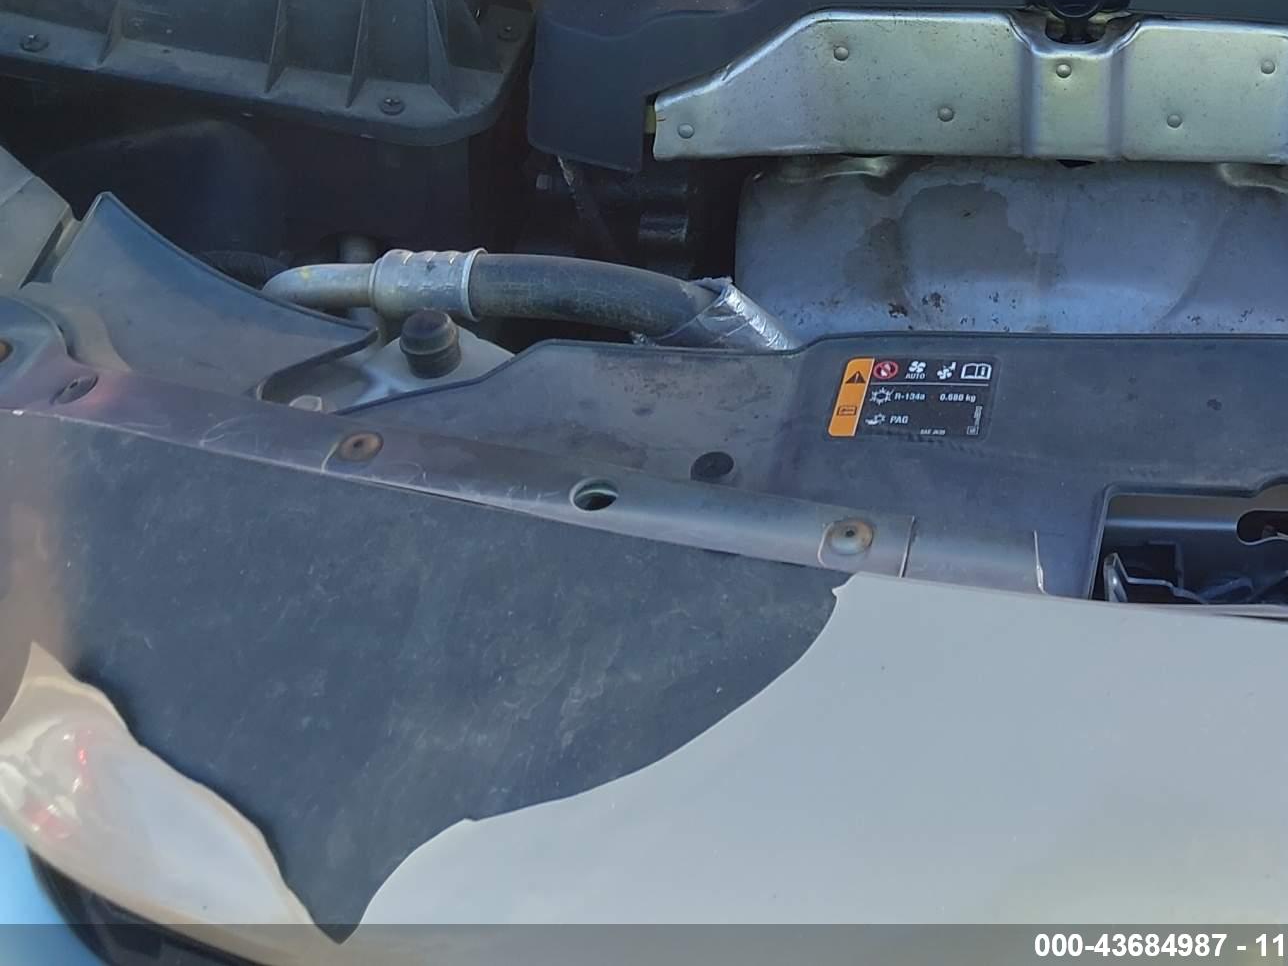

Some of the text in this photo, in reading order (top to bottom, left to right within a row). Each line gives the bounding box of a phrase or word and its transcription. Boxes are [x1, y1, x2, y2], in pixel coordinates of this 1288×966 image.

[894, 392, 926, 401] R-134a
[965, 393, 977, 403] kg
[889, 415, 909, 424] PAG
